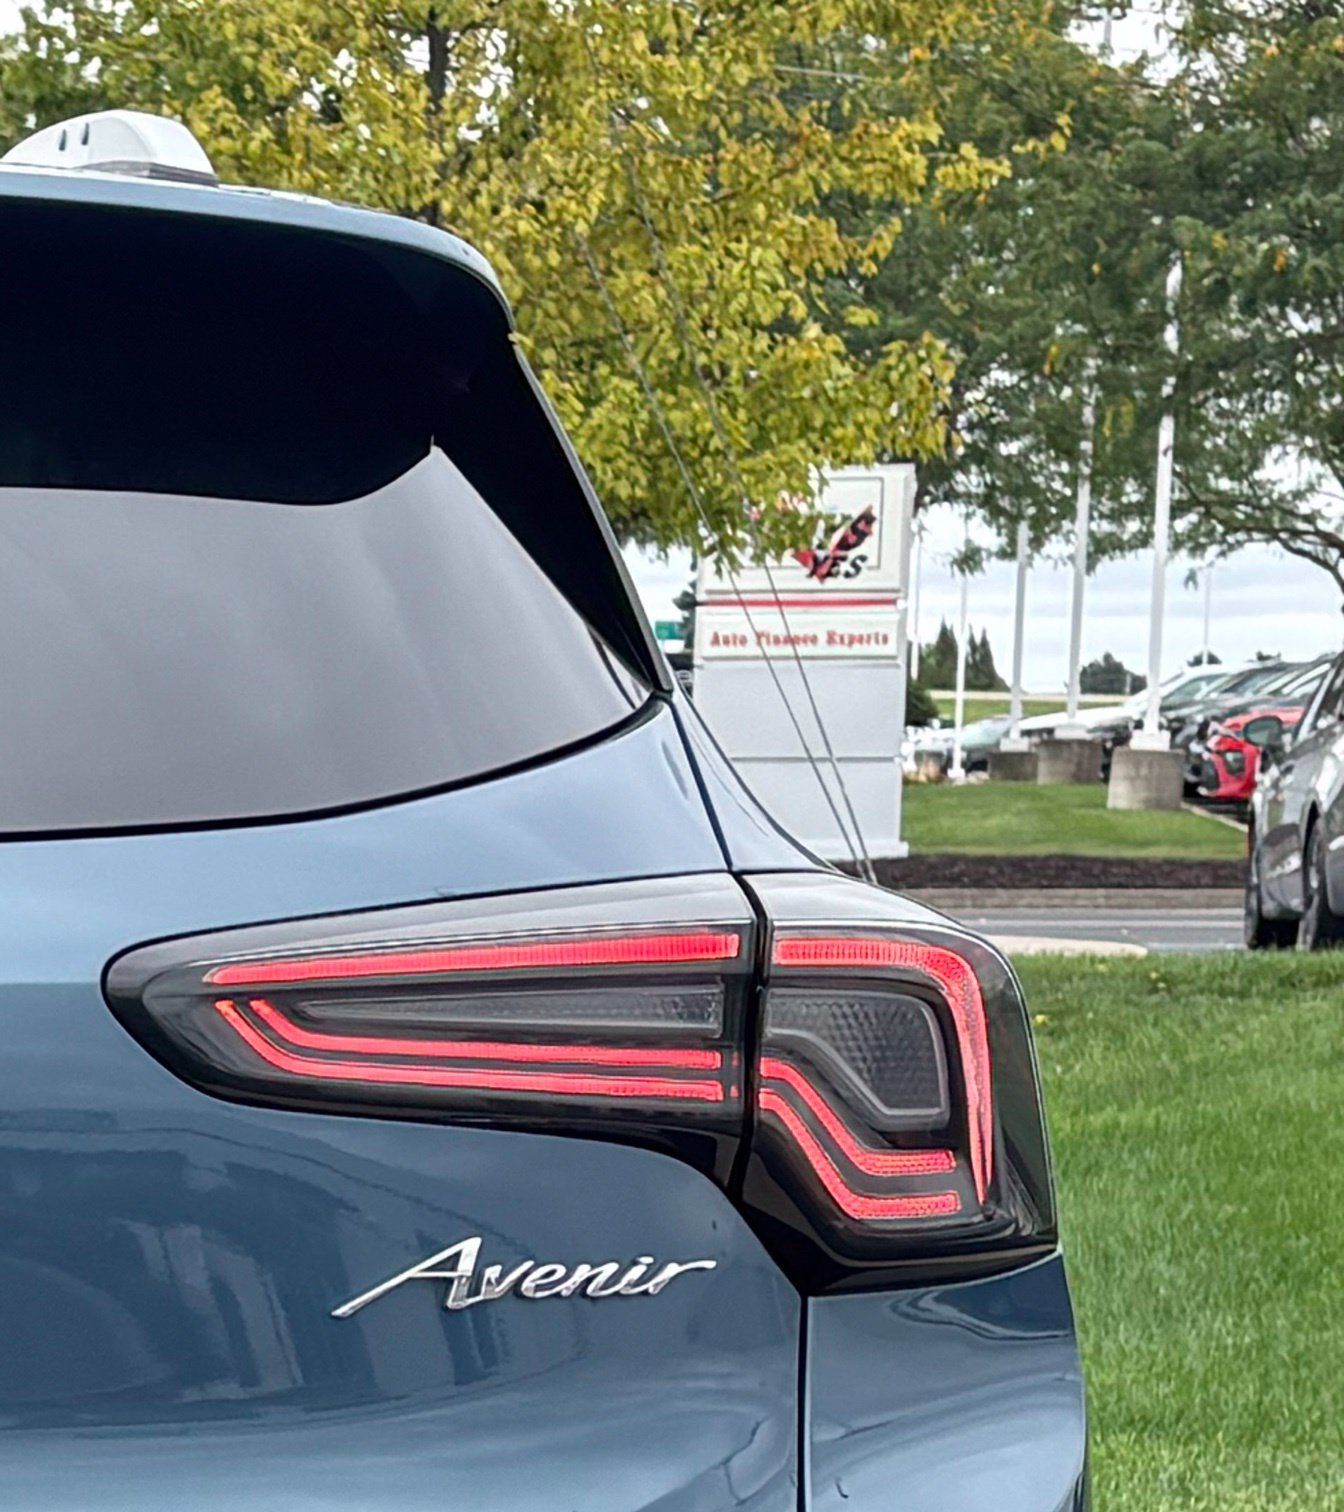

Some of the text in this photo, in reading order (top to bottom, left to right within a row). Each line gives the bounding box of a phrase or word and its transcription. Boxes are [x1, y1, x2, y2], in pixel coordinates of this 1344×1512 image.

[709, 630, 889, 649] Auto Finance Experts
[330, 1236, 717, 1318] Avenir
